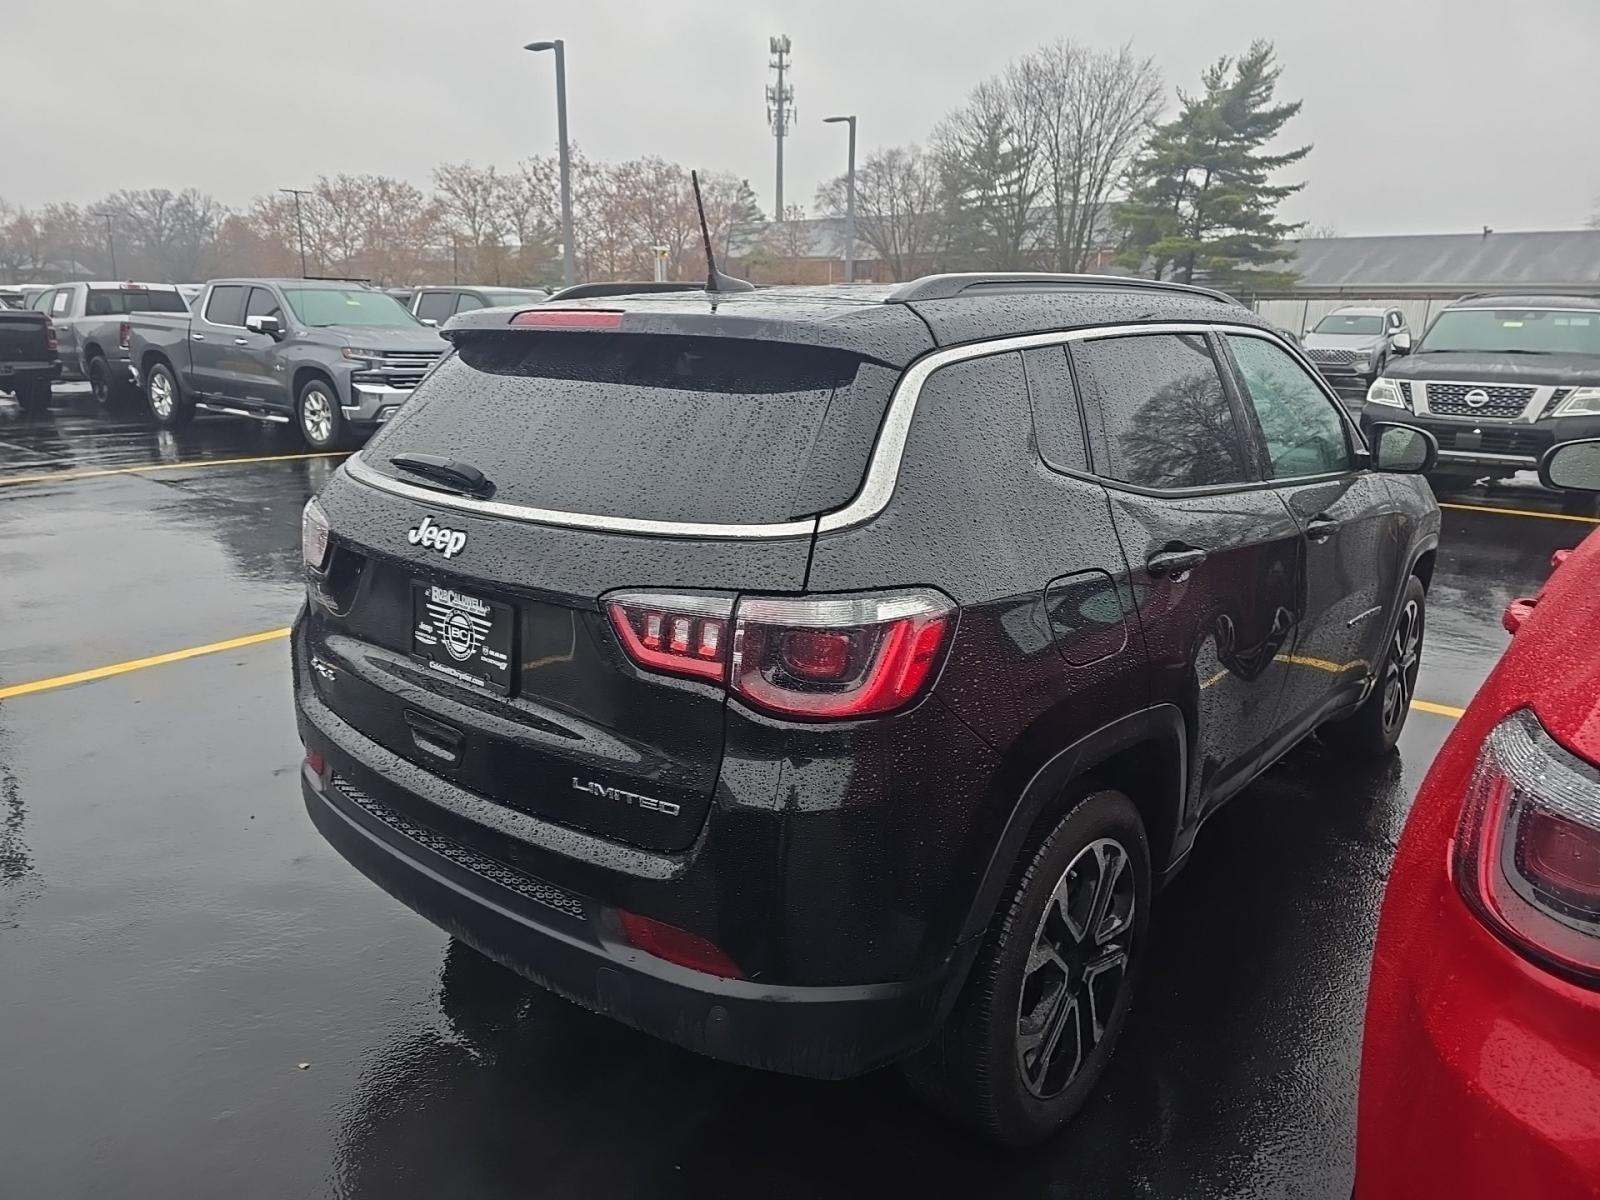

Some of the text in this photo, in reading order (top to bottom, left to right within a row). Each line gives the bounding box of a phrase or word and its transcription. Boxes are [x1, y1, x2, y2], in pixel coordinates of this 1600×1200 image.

[408, 517, 467, 559] Jeep
[451, 626, 468, 641] BC
[572, 777, 680, 816] LIMITED
